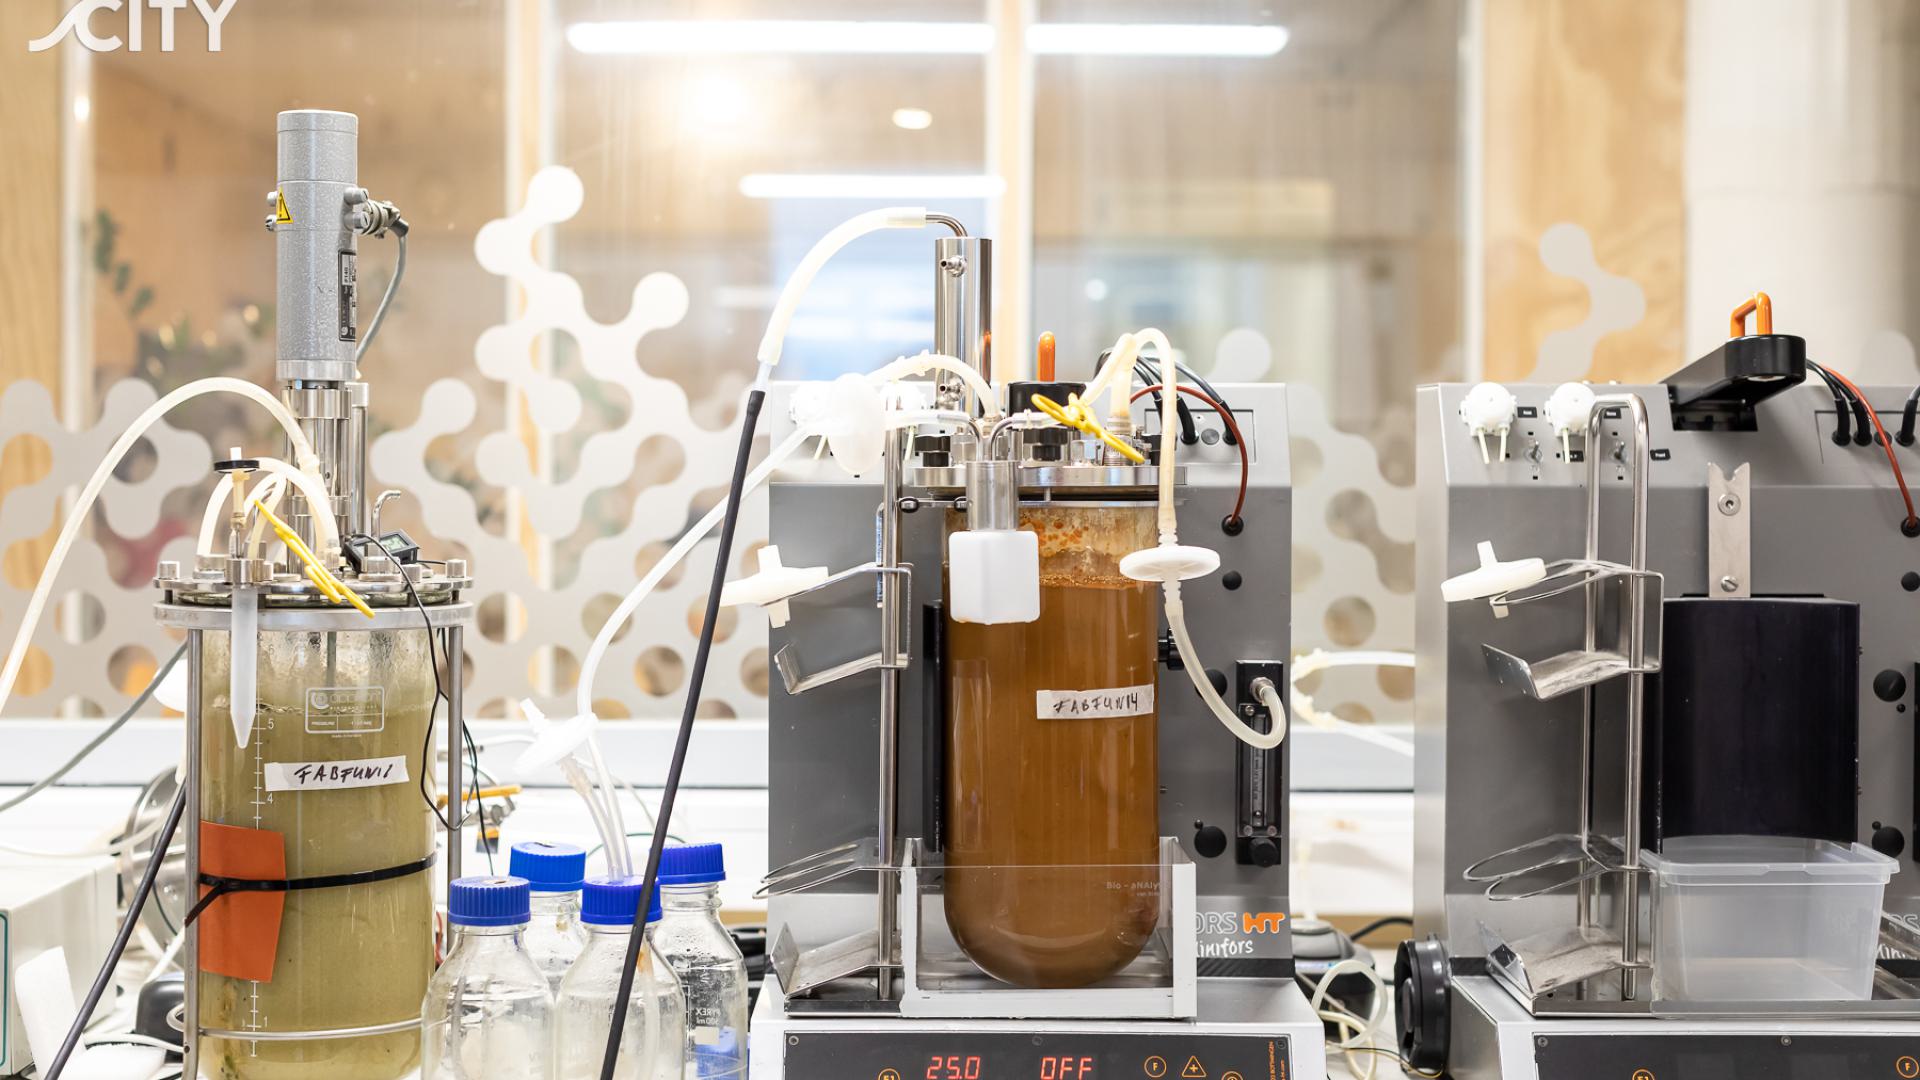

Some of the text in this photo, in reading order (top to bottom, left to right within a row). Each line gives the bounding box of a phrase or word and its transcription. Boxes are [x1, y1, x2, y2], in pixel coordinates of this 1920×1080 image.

[267, 719, 275, 730] 5
[267, 793, 273, 804] 4
[1196, 937, 1254, 958] inifors
[263, 1015, 268, 1028] 1
[926, 1056, 981, 1080] 25.0
[1040, 1057, 1093, 1080] OFF
[1152, 1062, 1159, 1072] F
[1905, 1062, 1912, 1071] F
